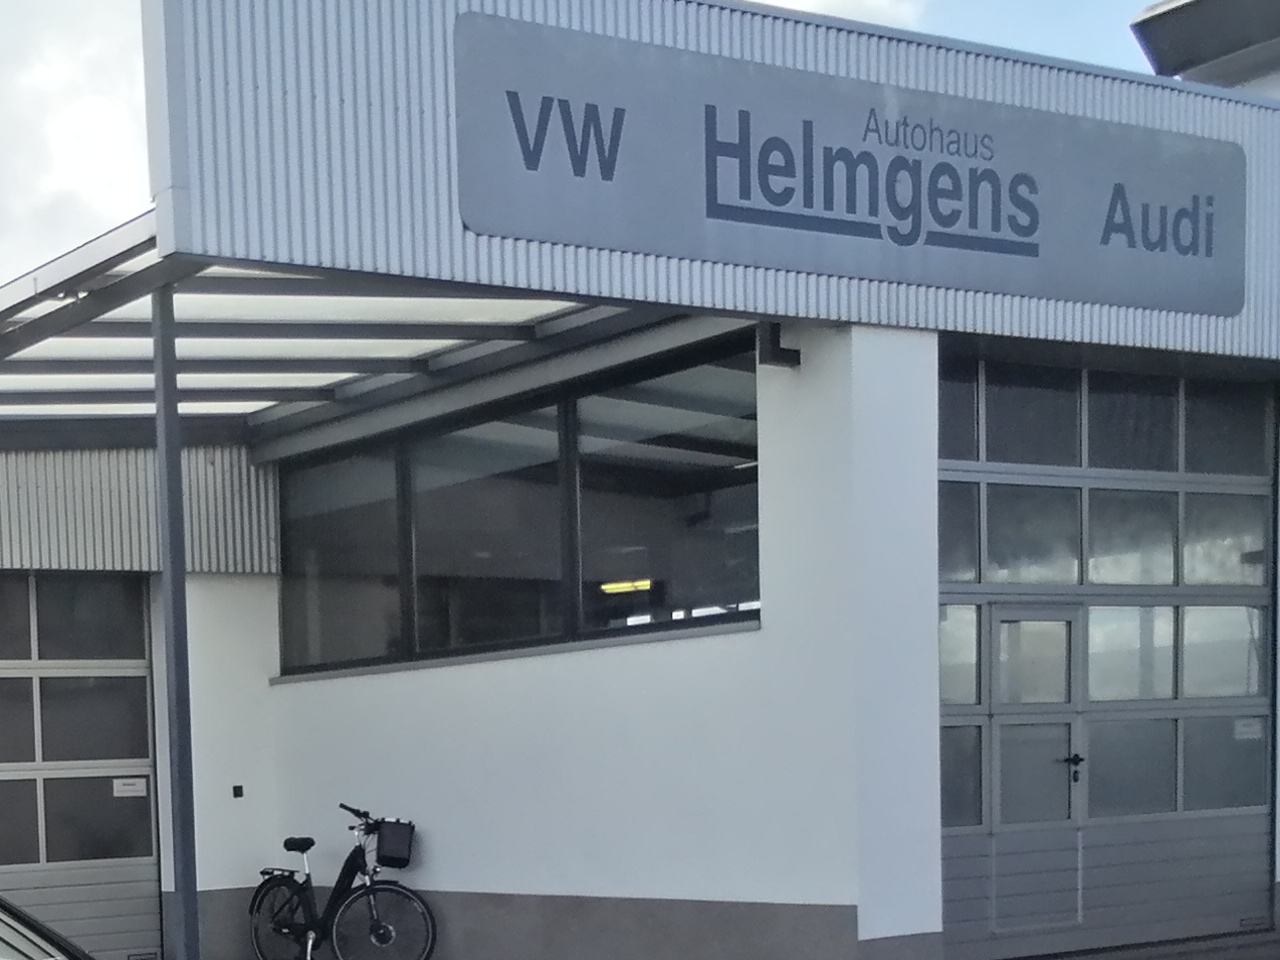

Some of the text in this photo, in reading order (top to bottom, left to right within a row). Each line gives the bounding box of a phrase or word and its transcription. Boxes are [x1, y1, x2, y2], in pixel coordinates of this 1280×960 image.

[505, 90, 626, 182] VW
[705, 104, 1040, 247] Helmgens
[862, 107, 995, 161] Autohaus
[1100, 182, 1216, 258] Audi
